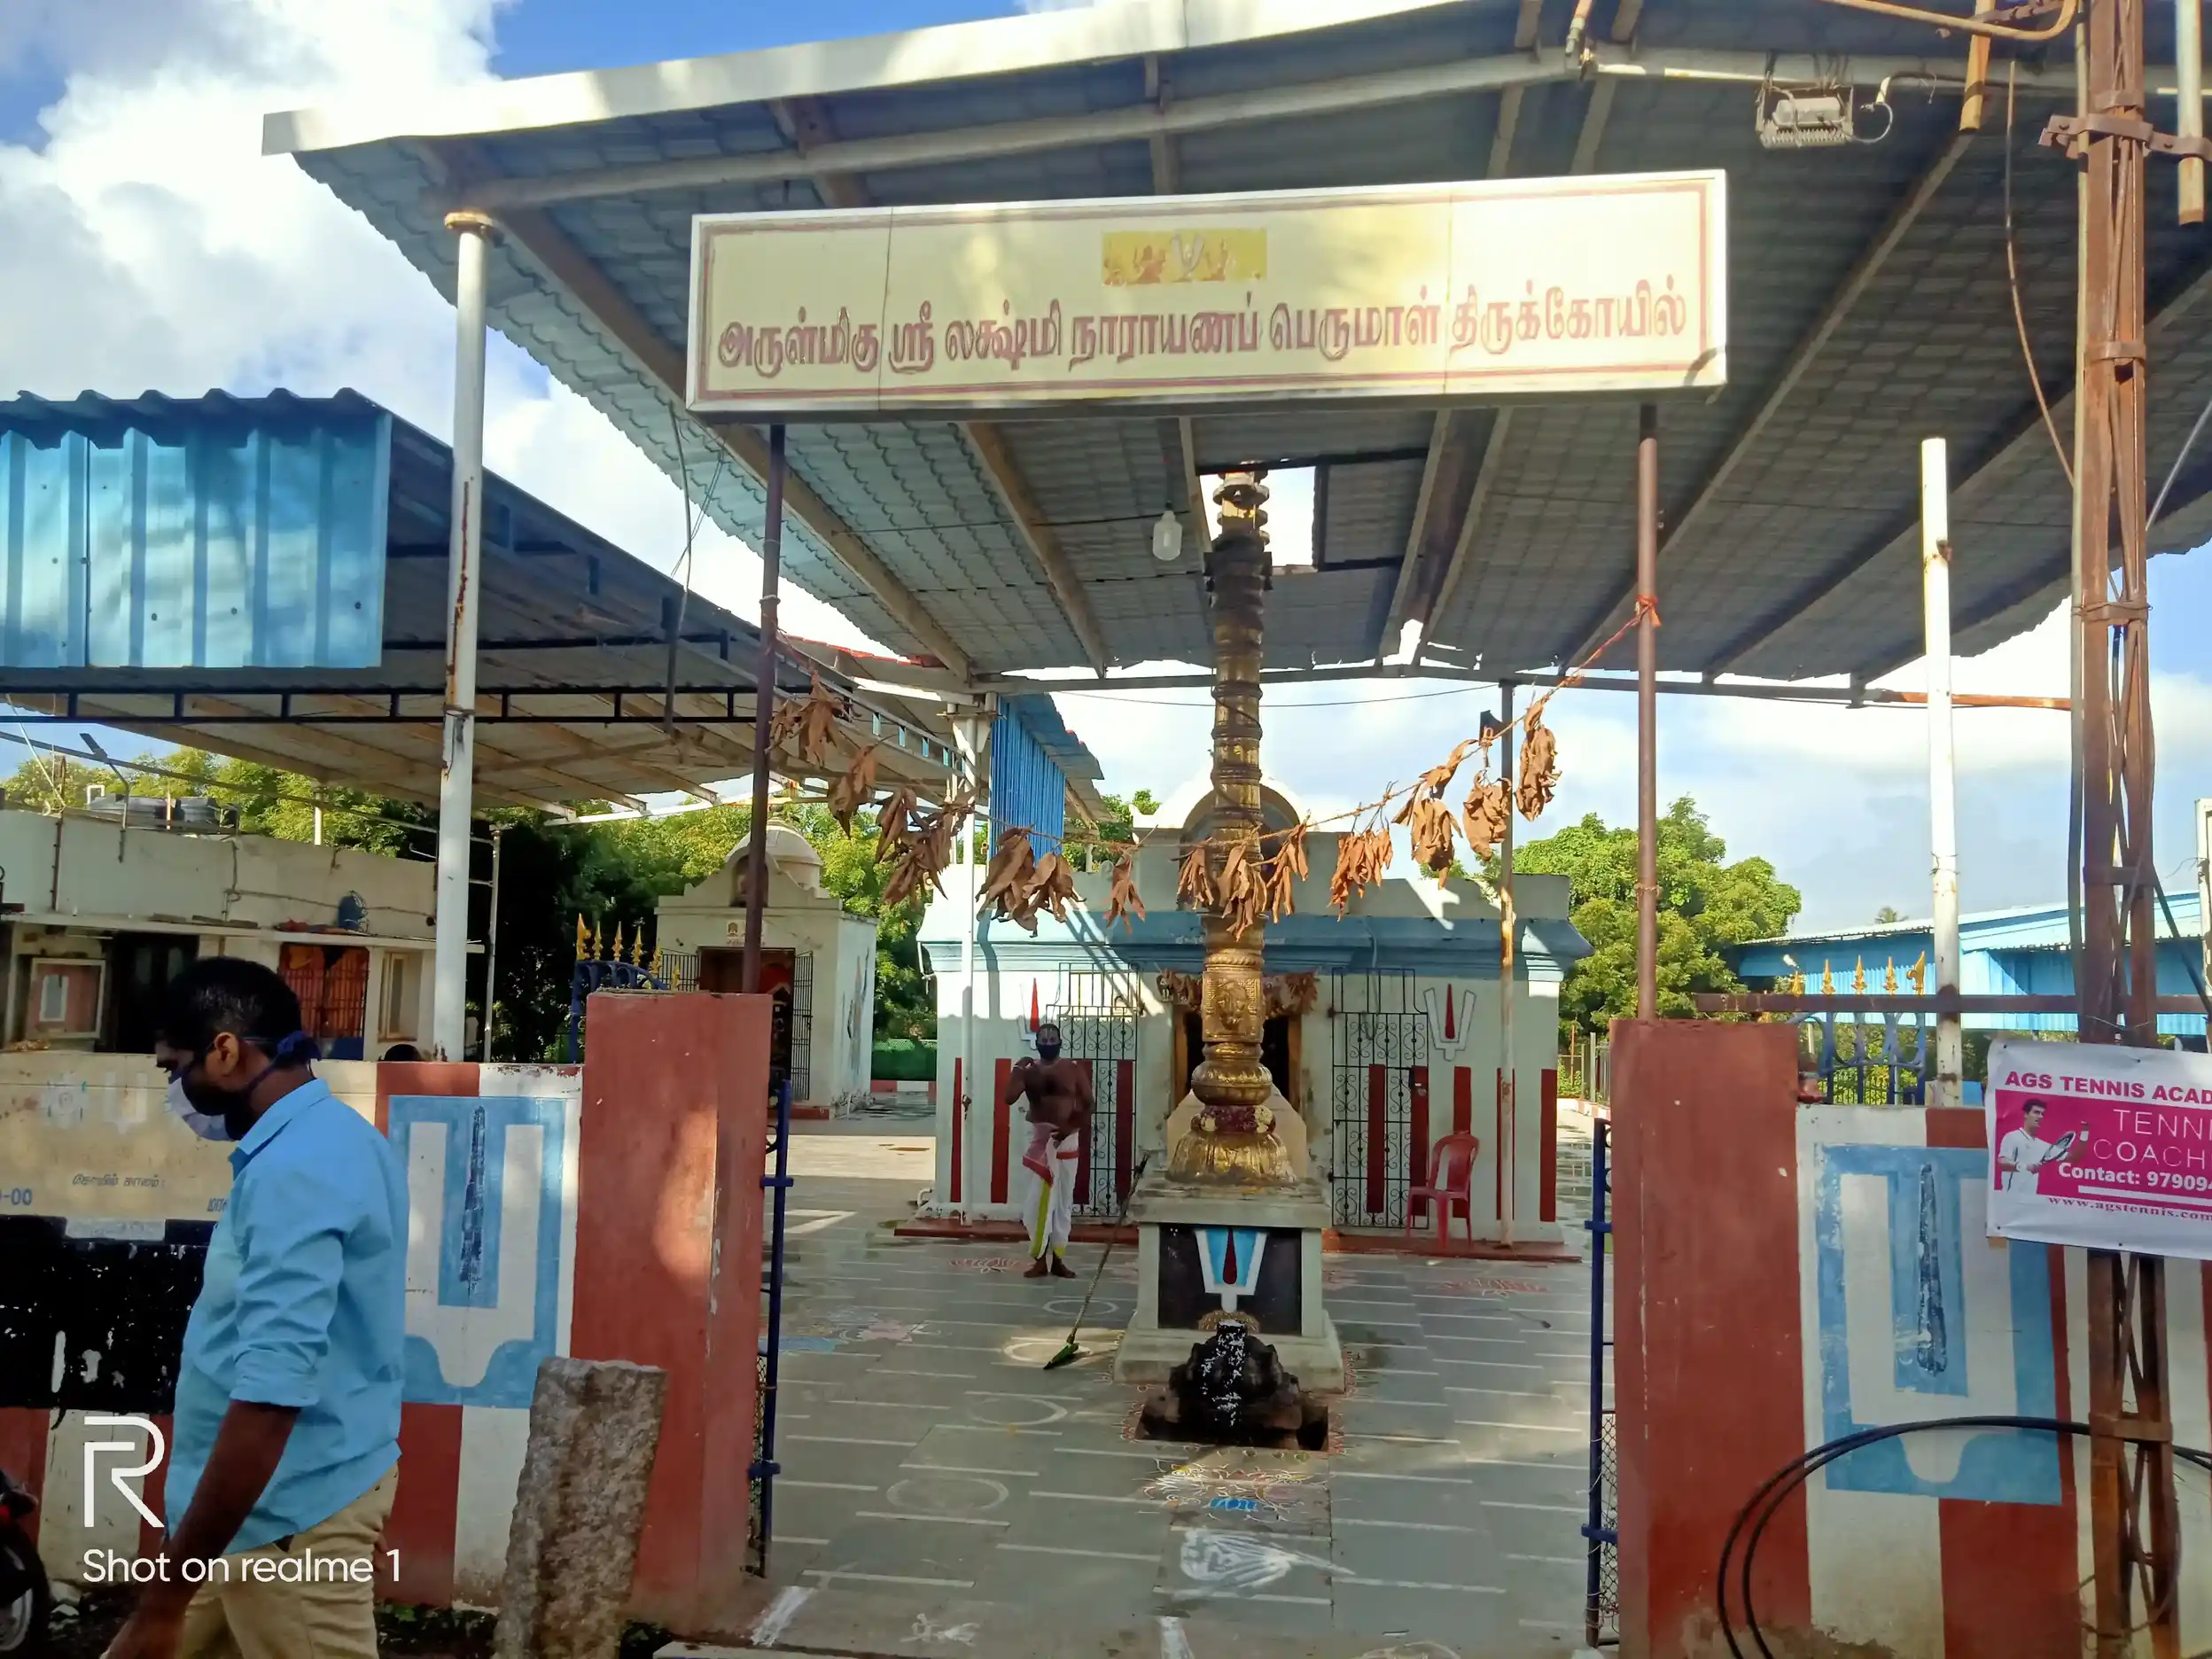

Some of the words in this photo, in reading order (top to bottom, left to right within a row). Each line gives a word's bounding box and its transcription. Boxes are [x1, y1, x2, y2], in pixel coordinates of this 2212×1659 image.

[718, 306, 878, 378] அருள்மிகு
[945, 298, 1062, 370] லக்ஷ்மி
[1068, 291, 1259, 372] நாராயணப்
[1268, 284, 1441, 362] பெருமாள்
[1448, 274, 1687, 354] திருக்கோயில்
[2005, 1071, 2053, 1090] AGS
[2060, 1076, 2146, 1099] TENNIS
[2092, 1139, 2212, 1171] COACH
[2058, 1162, 2140, 1185] Contact:
[2048, 1196, 2212, 1222] www.agstennis.com
